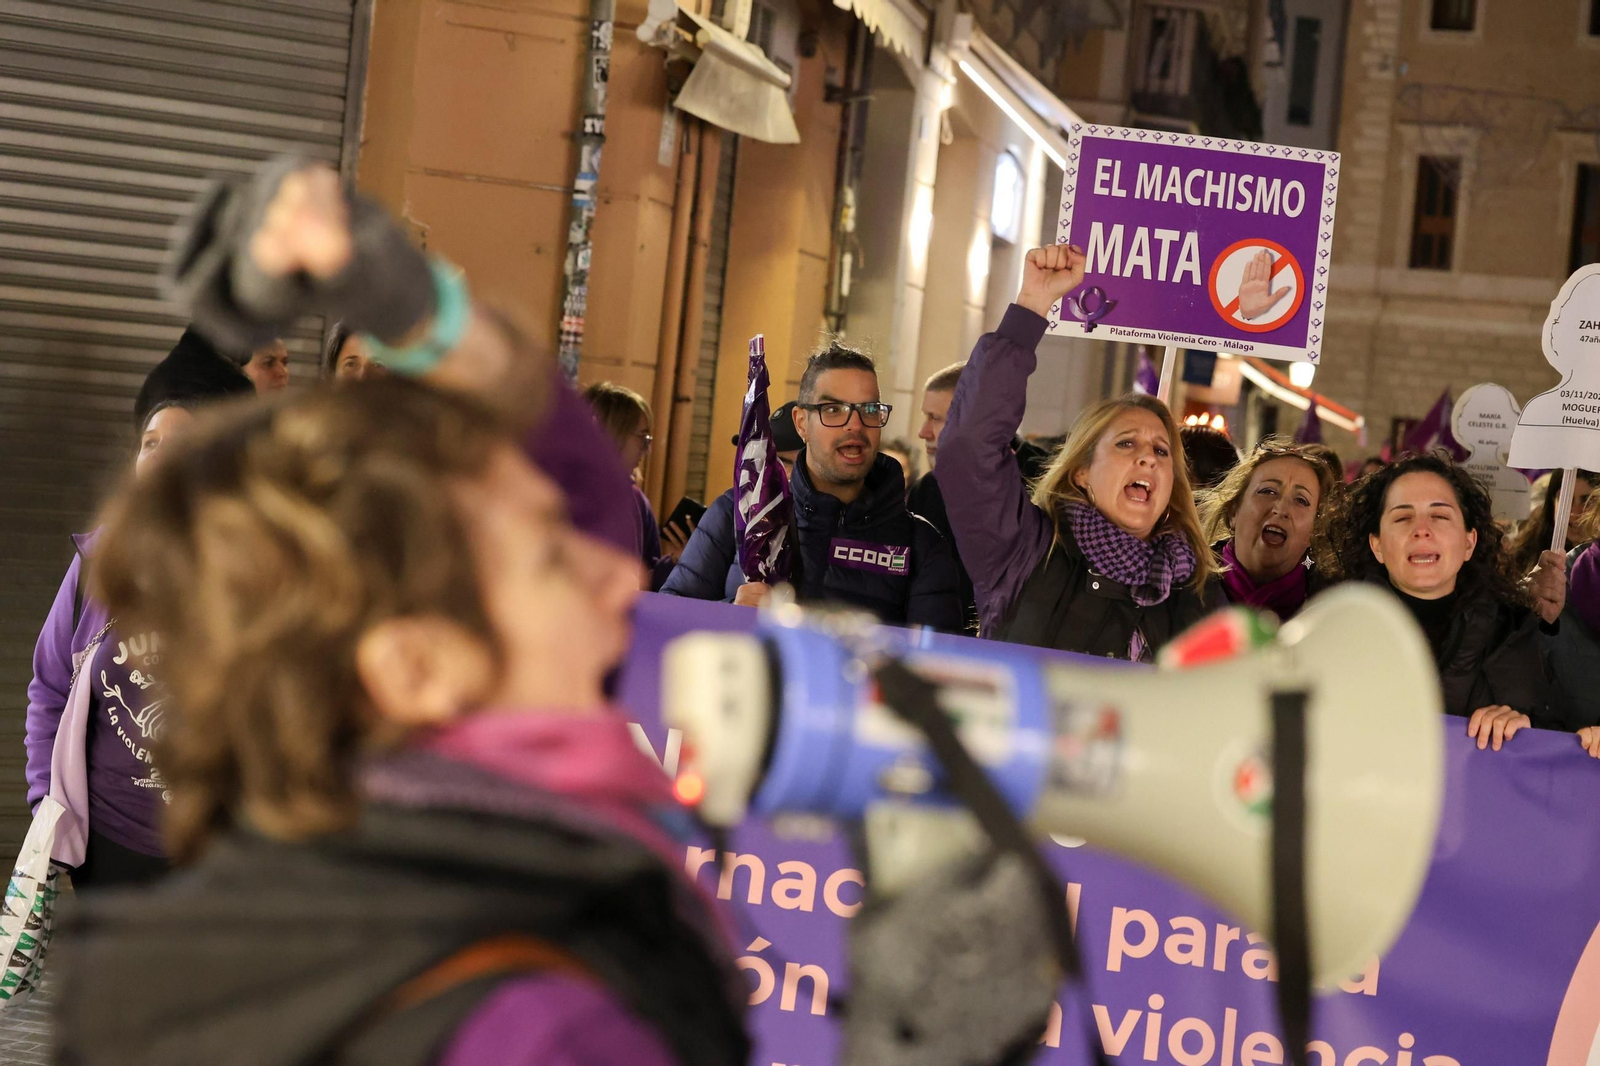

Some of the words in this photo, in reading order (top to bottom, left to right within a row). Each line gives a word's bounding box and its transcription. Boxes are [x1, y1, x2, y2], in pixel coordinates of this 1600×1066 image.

[1094, 158, 1127, 198] EL
[1134, 162, 1306, 218] MACHISMO
[1084, 221, 1202, 286] MATA
[1109, 327, 1156, 340] Plataforma
[1157, 332, 1196, 344] Violencia
[1197, 336, 1217, 347] Cero
[1223, 339, 1254, 352] Málaga
[1562, 415, 1600, 428] (Huelva)
[107, 706, 119, 726] LA
[1106, 906, 1280, 973] para
